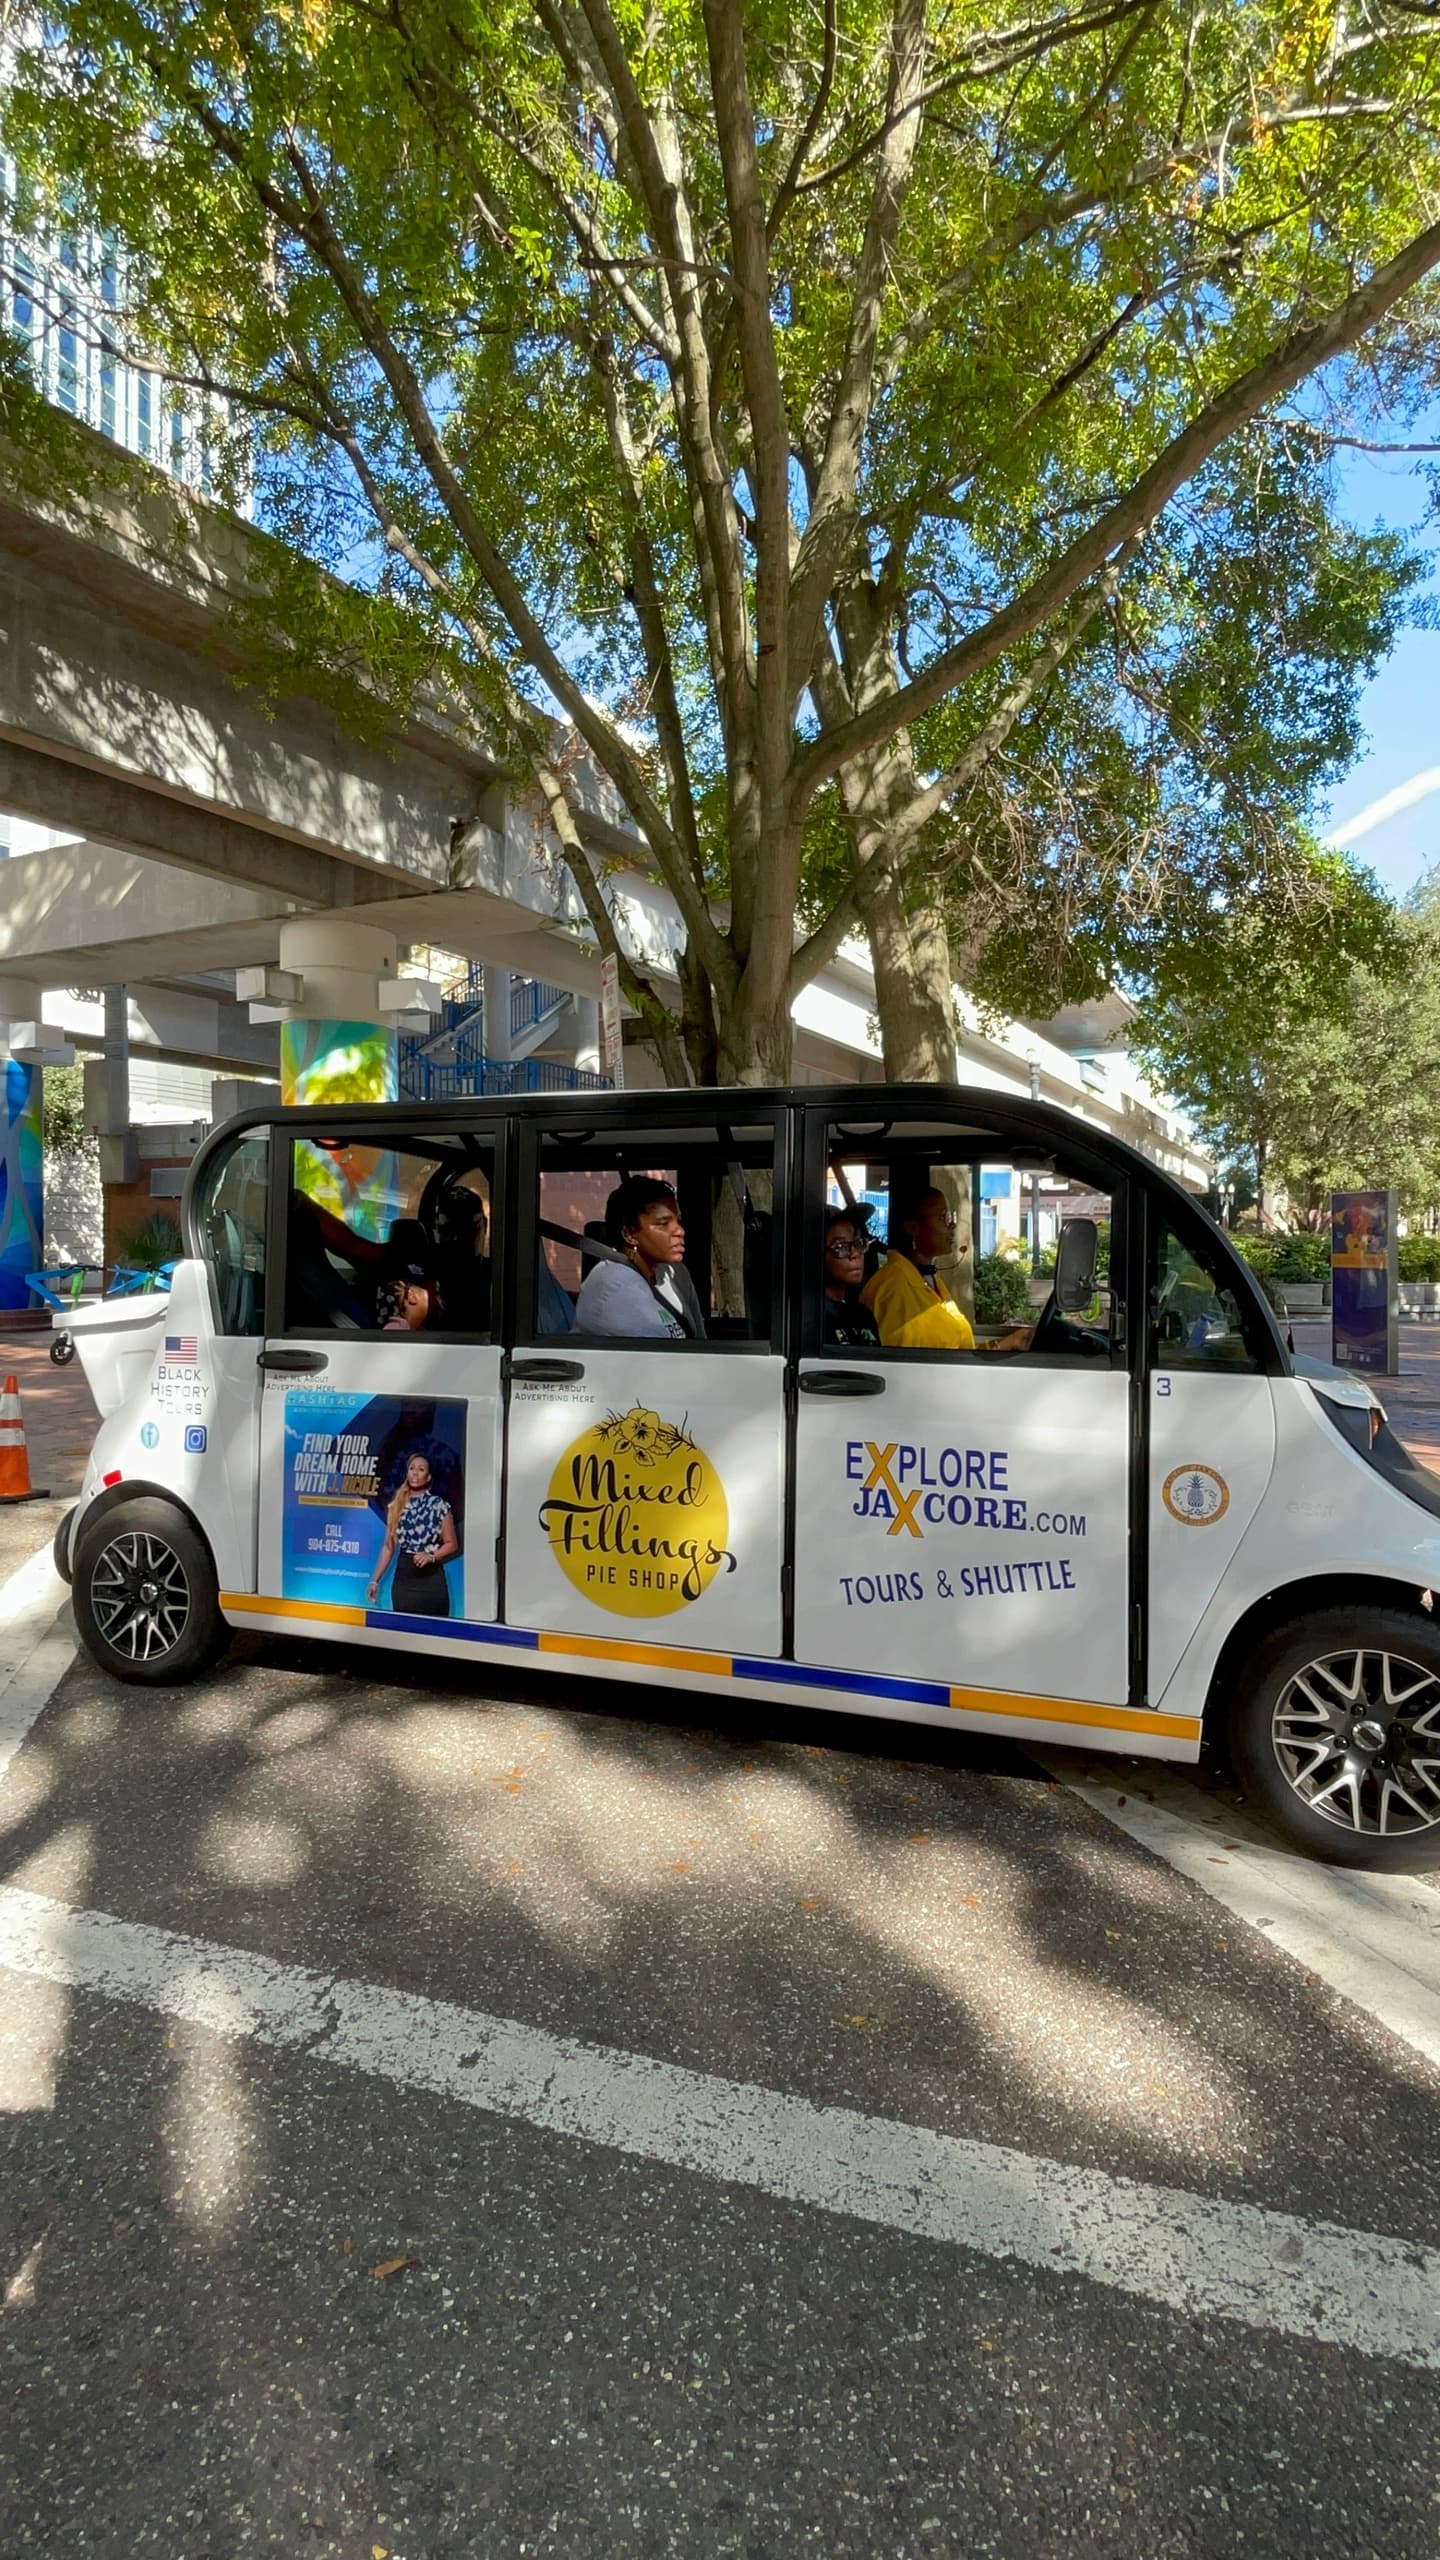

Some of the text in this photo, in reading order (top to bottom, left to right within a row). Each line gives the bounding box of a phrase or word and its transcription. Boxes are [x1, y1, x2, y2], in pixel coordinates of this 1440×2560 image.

[158, 1366, 201, 1381] BLACK
[151, 1382, 209, 1398] HISTORY
[515, 1392, 595, 1403] ADVERTISING HERE
[522, 1382, 587, 1393] ASK ME ABOUT
[1156, 1377, 1172, 1397] 3
[303, 1433, 370, 1455] FIND YOUR
[294, 1452, 380, 1476] DREAM HOME
[846, 1441, 1009, 1491] EXPLORE
[294, 1473, 328, 1492] WITH
[572, 1454, 710, 1508] Mixed
[325, 1523, 342, 1537] CALL
[538, 1499, 737, 1601] Fillings
[586, 1564, 679, 1591] PIE SHOP
[840, 1559, 1076, 1606] TOURS & SHUTTLE
